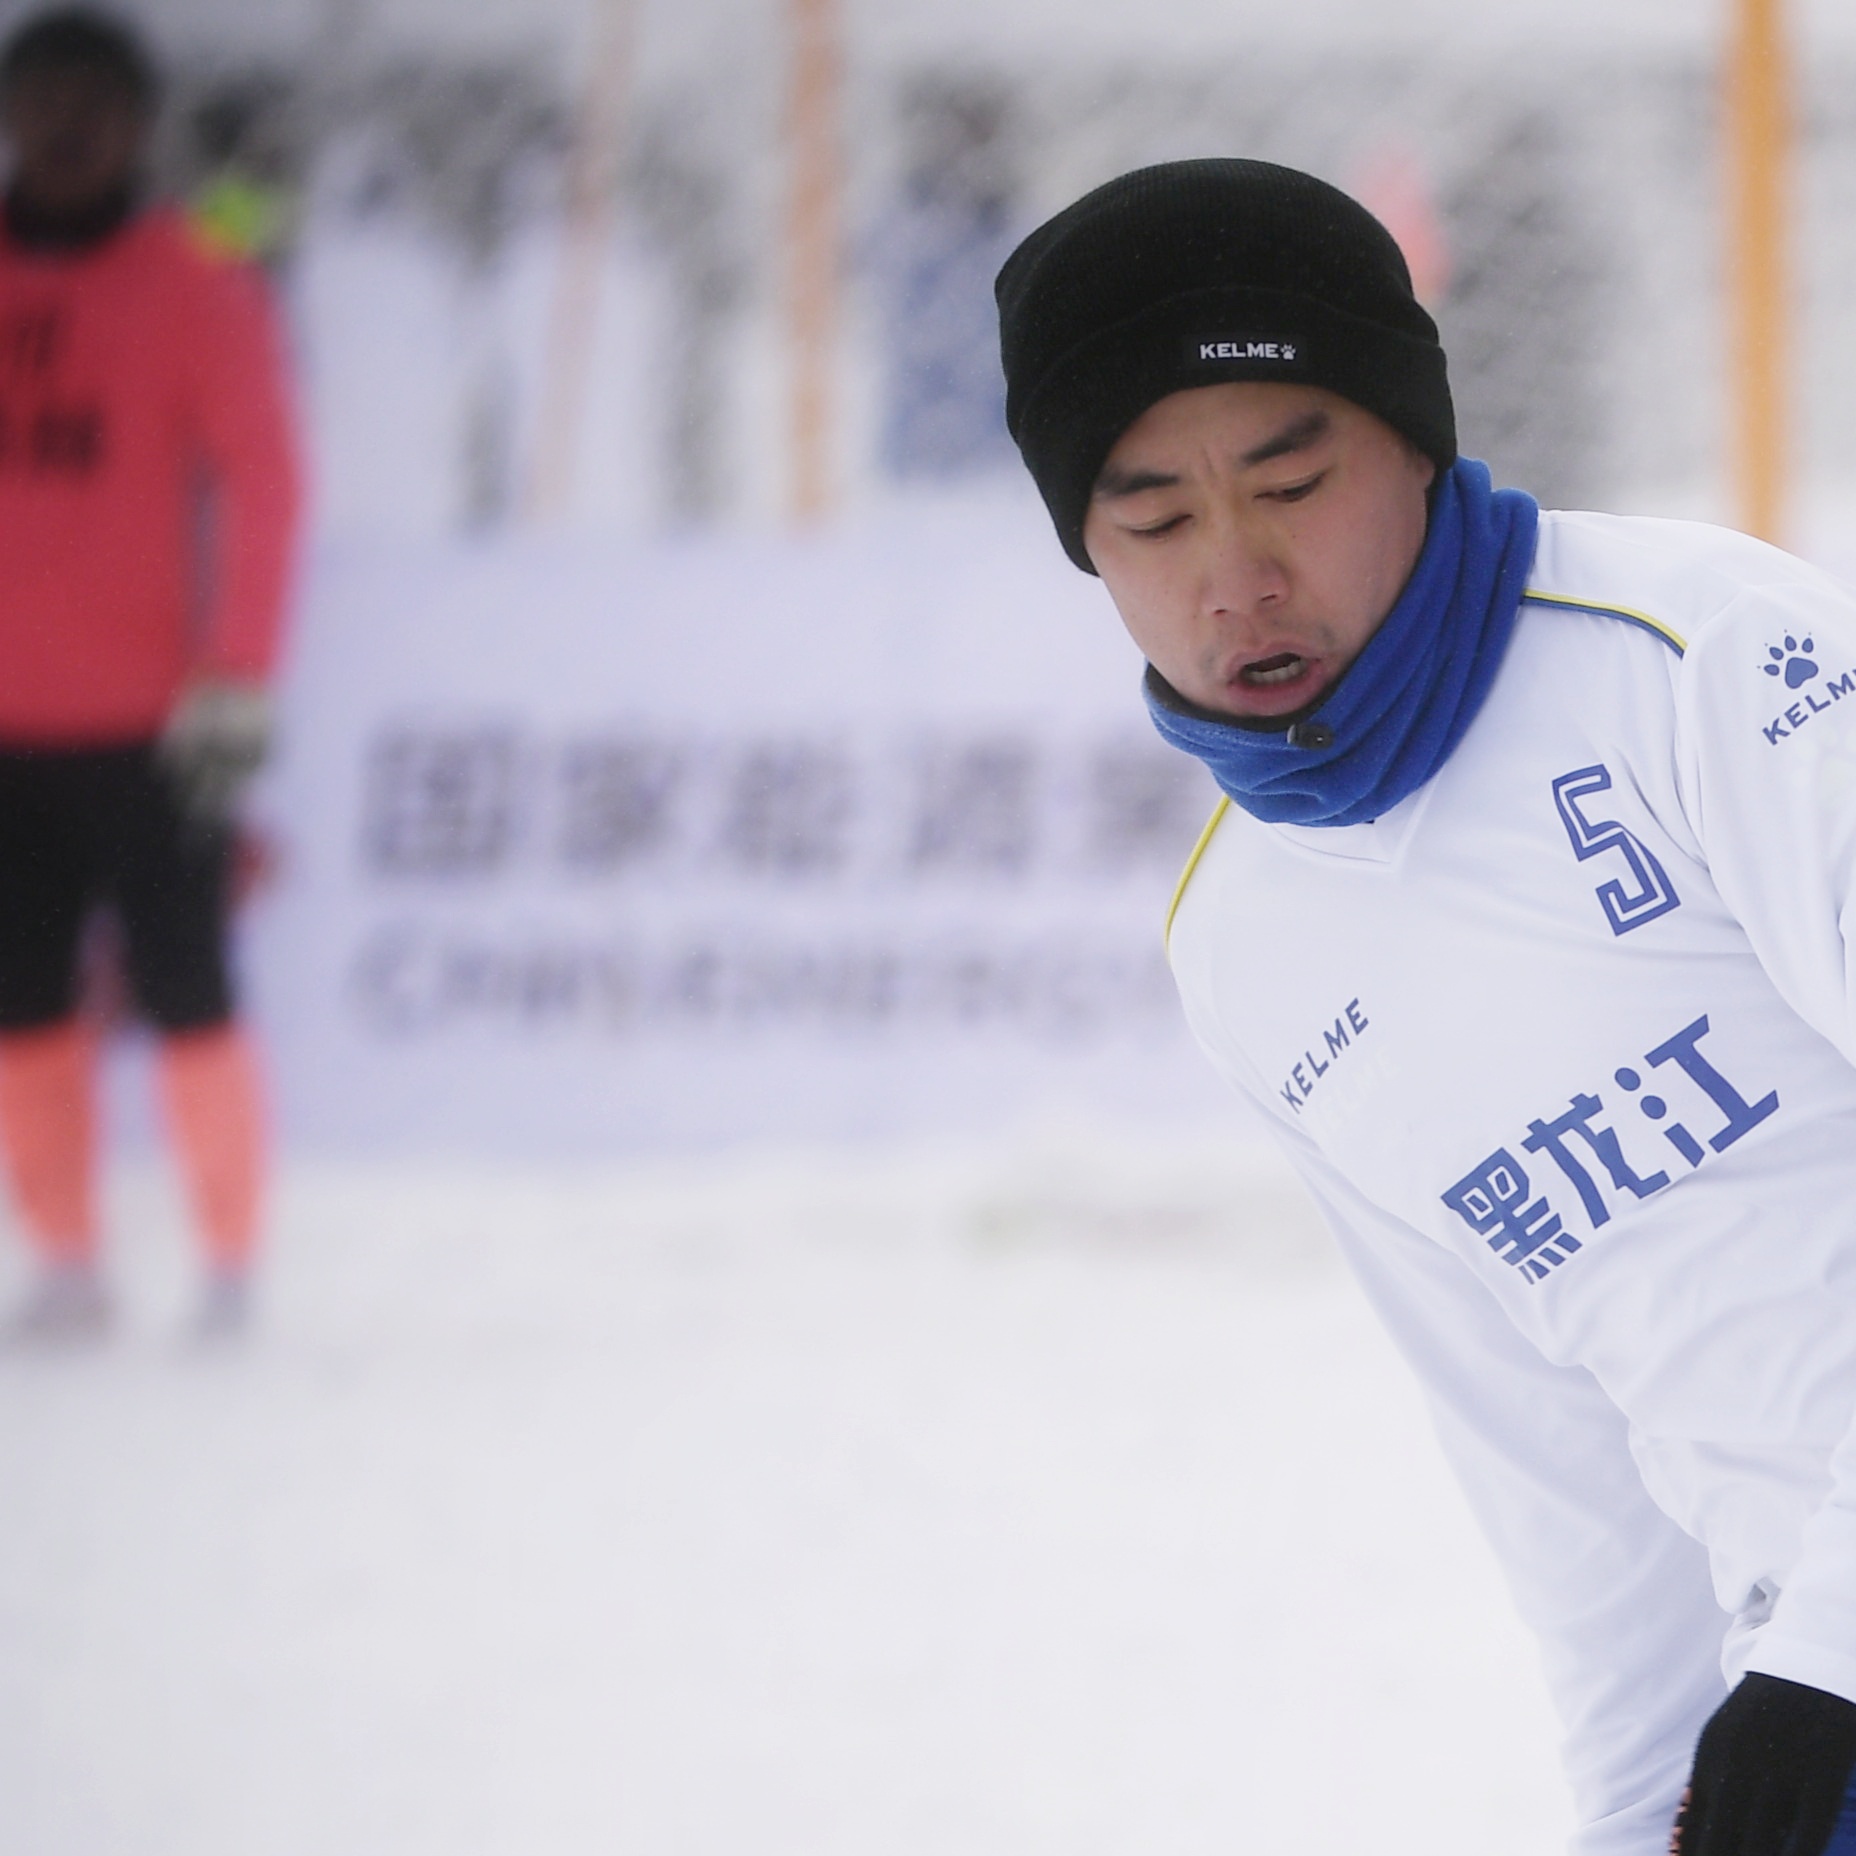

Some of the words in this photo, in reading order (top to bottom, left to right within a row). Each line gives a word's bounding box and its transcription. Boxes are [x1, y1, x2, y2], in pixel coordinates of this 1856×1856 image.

[1199, 342, 1280, 360] KELME
[1551, 763, 1681, 937] 5
[1279, 997, 1369, 1115] KELME
[1440, 1013, 1780, 1286] 黑龙江
